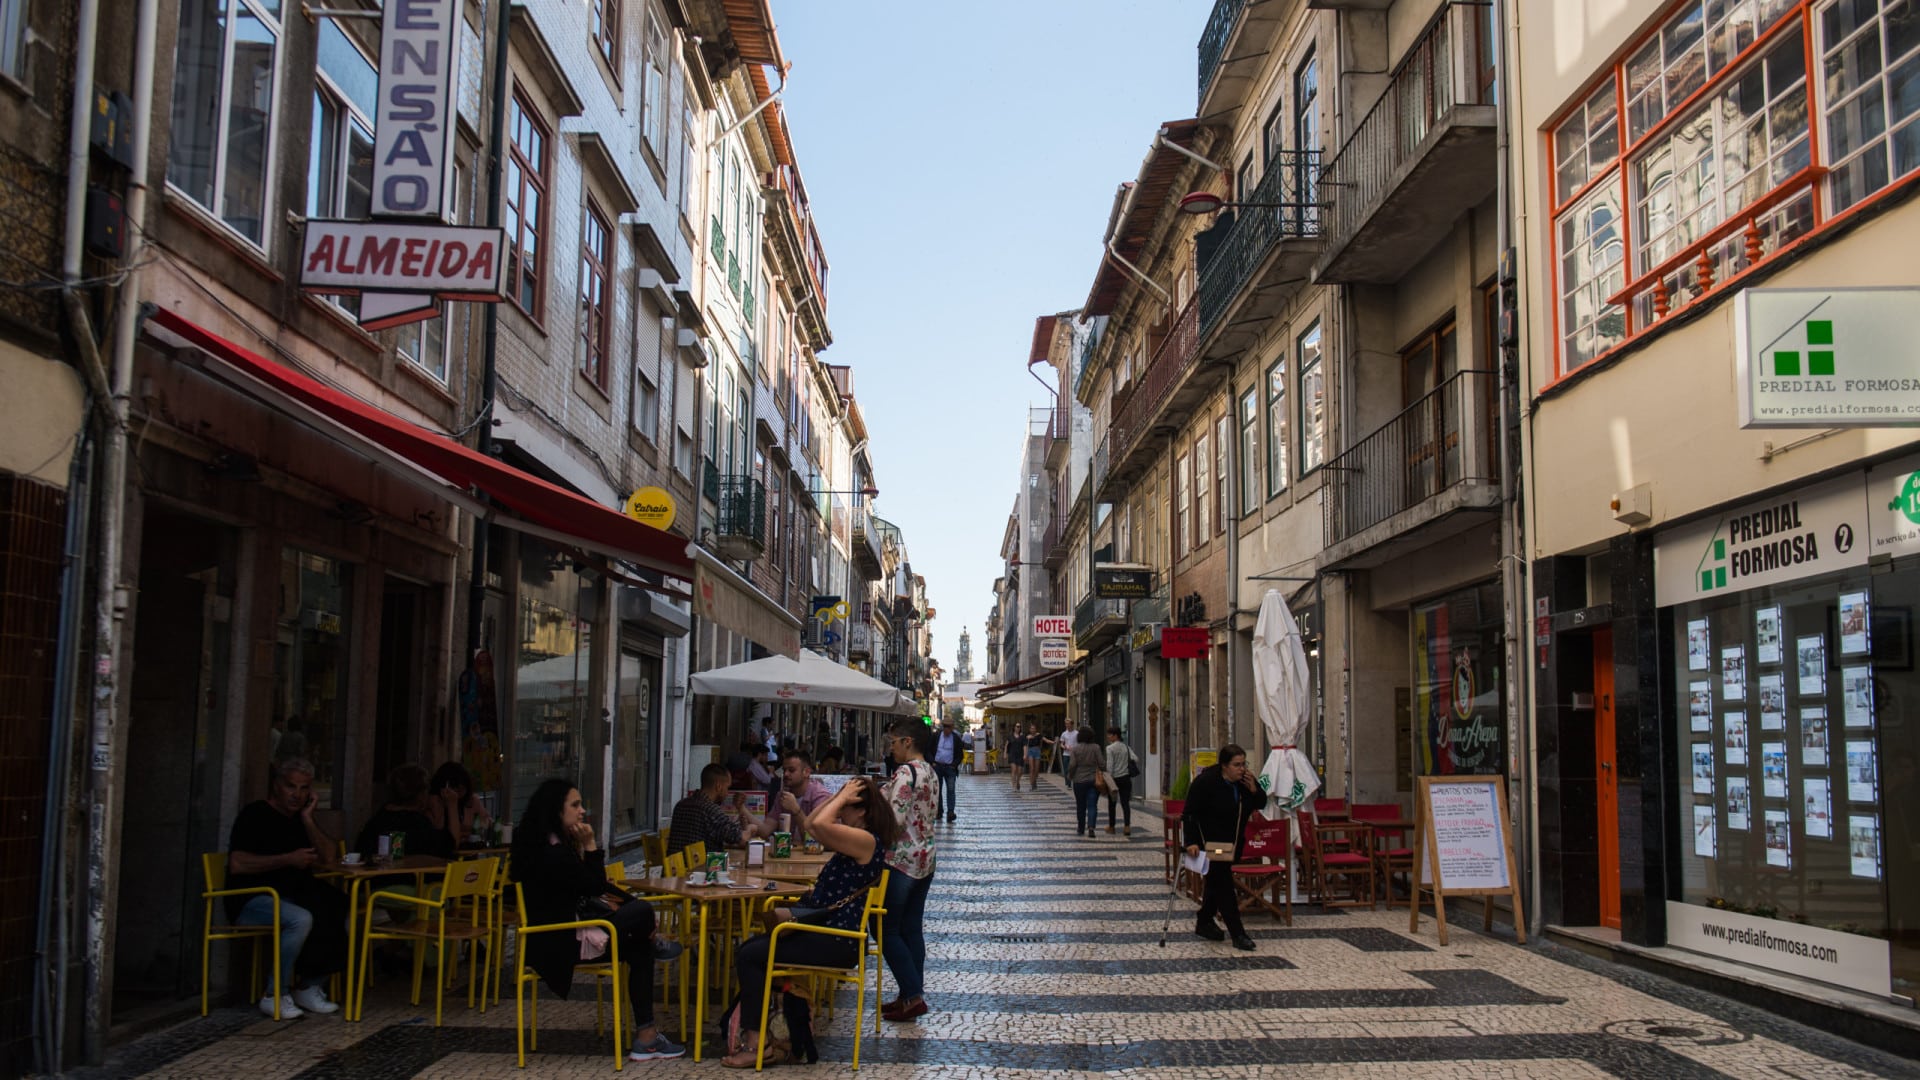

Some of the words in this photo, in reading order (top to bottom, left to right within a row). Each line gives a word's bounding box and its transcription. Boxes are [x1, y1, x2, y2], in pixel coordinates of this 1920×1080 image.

[306, 234, 493, 279] ALMEIDA
[1760, 380, 1836, 393] PREDIAL
[1845, 379, 1920, 392] FORMOSA
[1729, 501, 1802, 545] PREDIAL
[1731, 532, 1819, 579] FORMOSA
[1036, 619, 1071, 634] HOTEL
[1702, 921, 1838, 964] www.predialformosa.com
